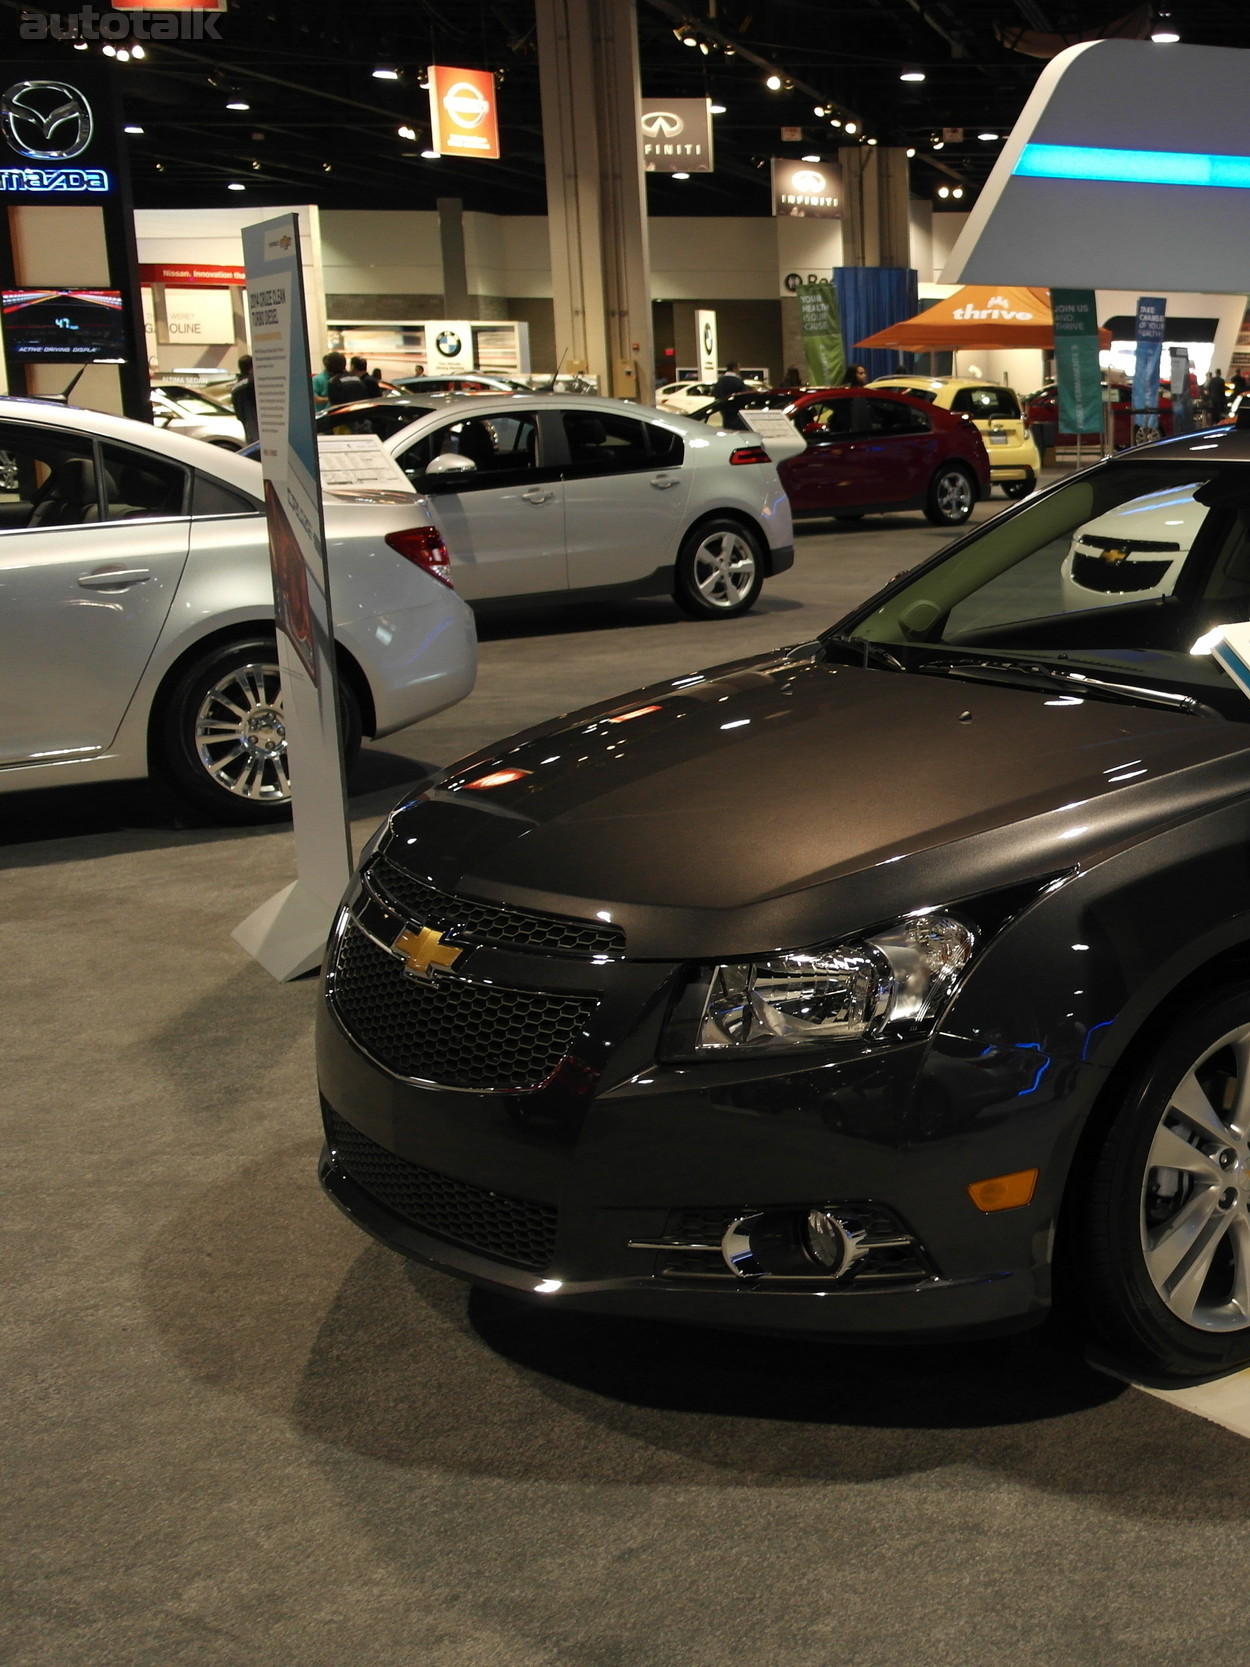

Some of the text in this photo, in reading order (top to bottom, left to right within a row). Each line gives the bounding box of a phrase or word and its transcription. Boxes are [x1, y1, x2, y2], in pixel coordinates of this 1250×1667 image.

[644, 144, 702, 155] FINITI
[781, 194, 839, 207] INFINITI
[163, 270, 192, 278] Nissan.
[193, 270, 233, 279] Innovation
[801, 295, 822, 304] YOUR
[952, 303, 1033, 320] thrive
[1077, 304, 1088, 312] US
[804, 322, 829, 331] CAUSE
[1055, 322, 1085, 331] THRIVE
